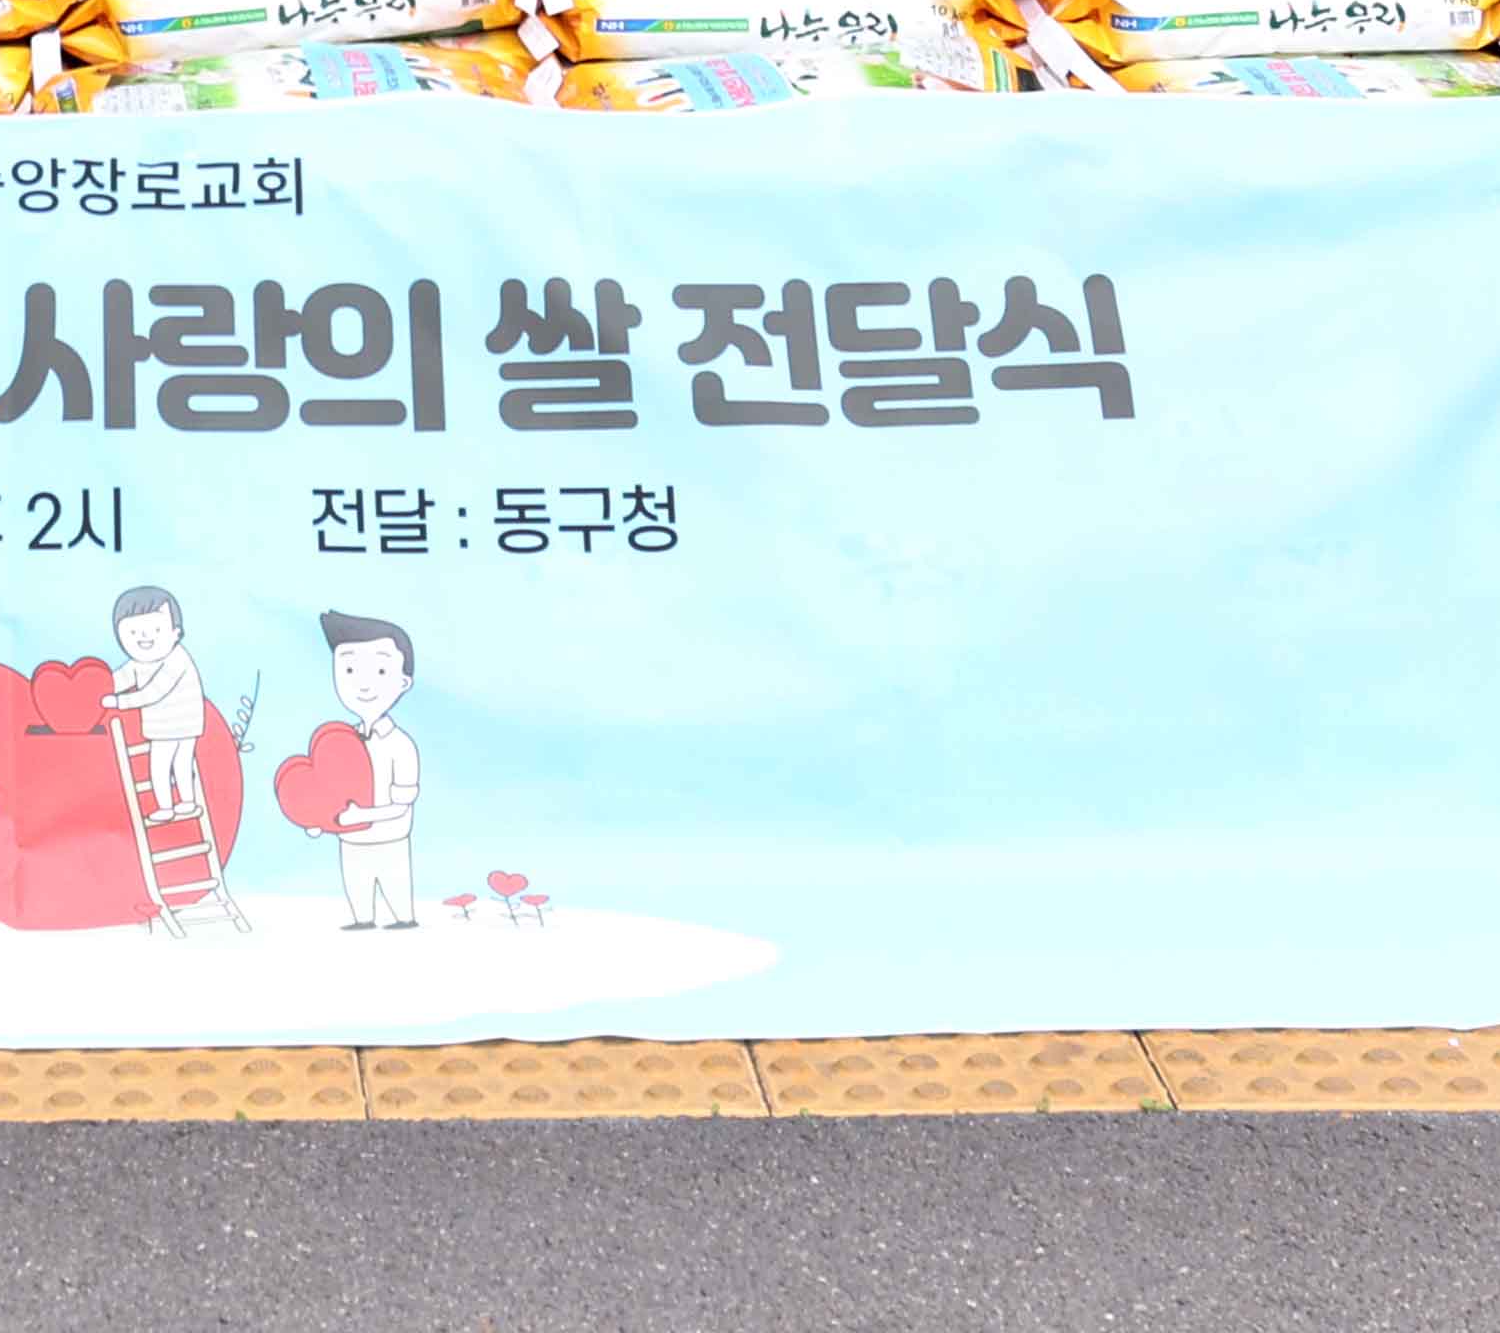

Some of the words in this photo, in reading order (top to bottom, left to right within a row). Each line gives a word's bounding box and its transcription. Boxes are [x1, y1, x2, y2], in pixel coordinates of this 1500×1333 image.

[485, 277, 642, 431] 쌀
[672, 274, 1135, 427] 전달식
[27, 486, 122, 553] 2시
[312, 488, 436, 554] 전달
[494, 484, 678, 554] 동구청
